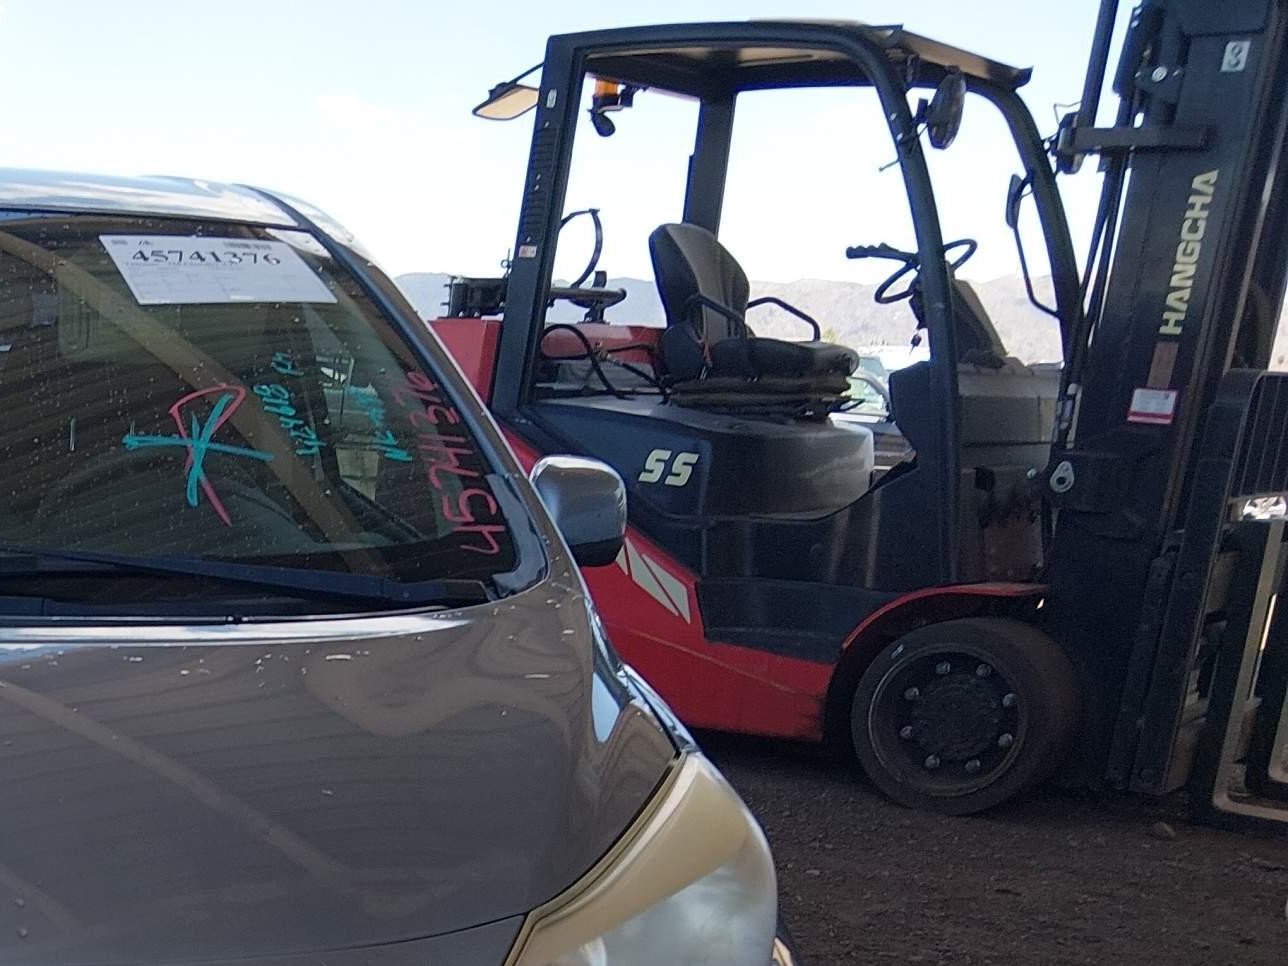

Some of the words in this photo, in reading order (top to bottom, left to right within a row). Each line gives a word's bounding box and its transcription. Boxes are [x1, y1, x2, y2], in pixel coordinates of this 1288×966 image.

[132, 249, 281, 265] 45741376
[1158, 169, 1219, 336] HANGCHA
[392, 370, 506, 555] 45741376
